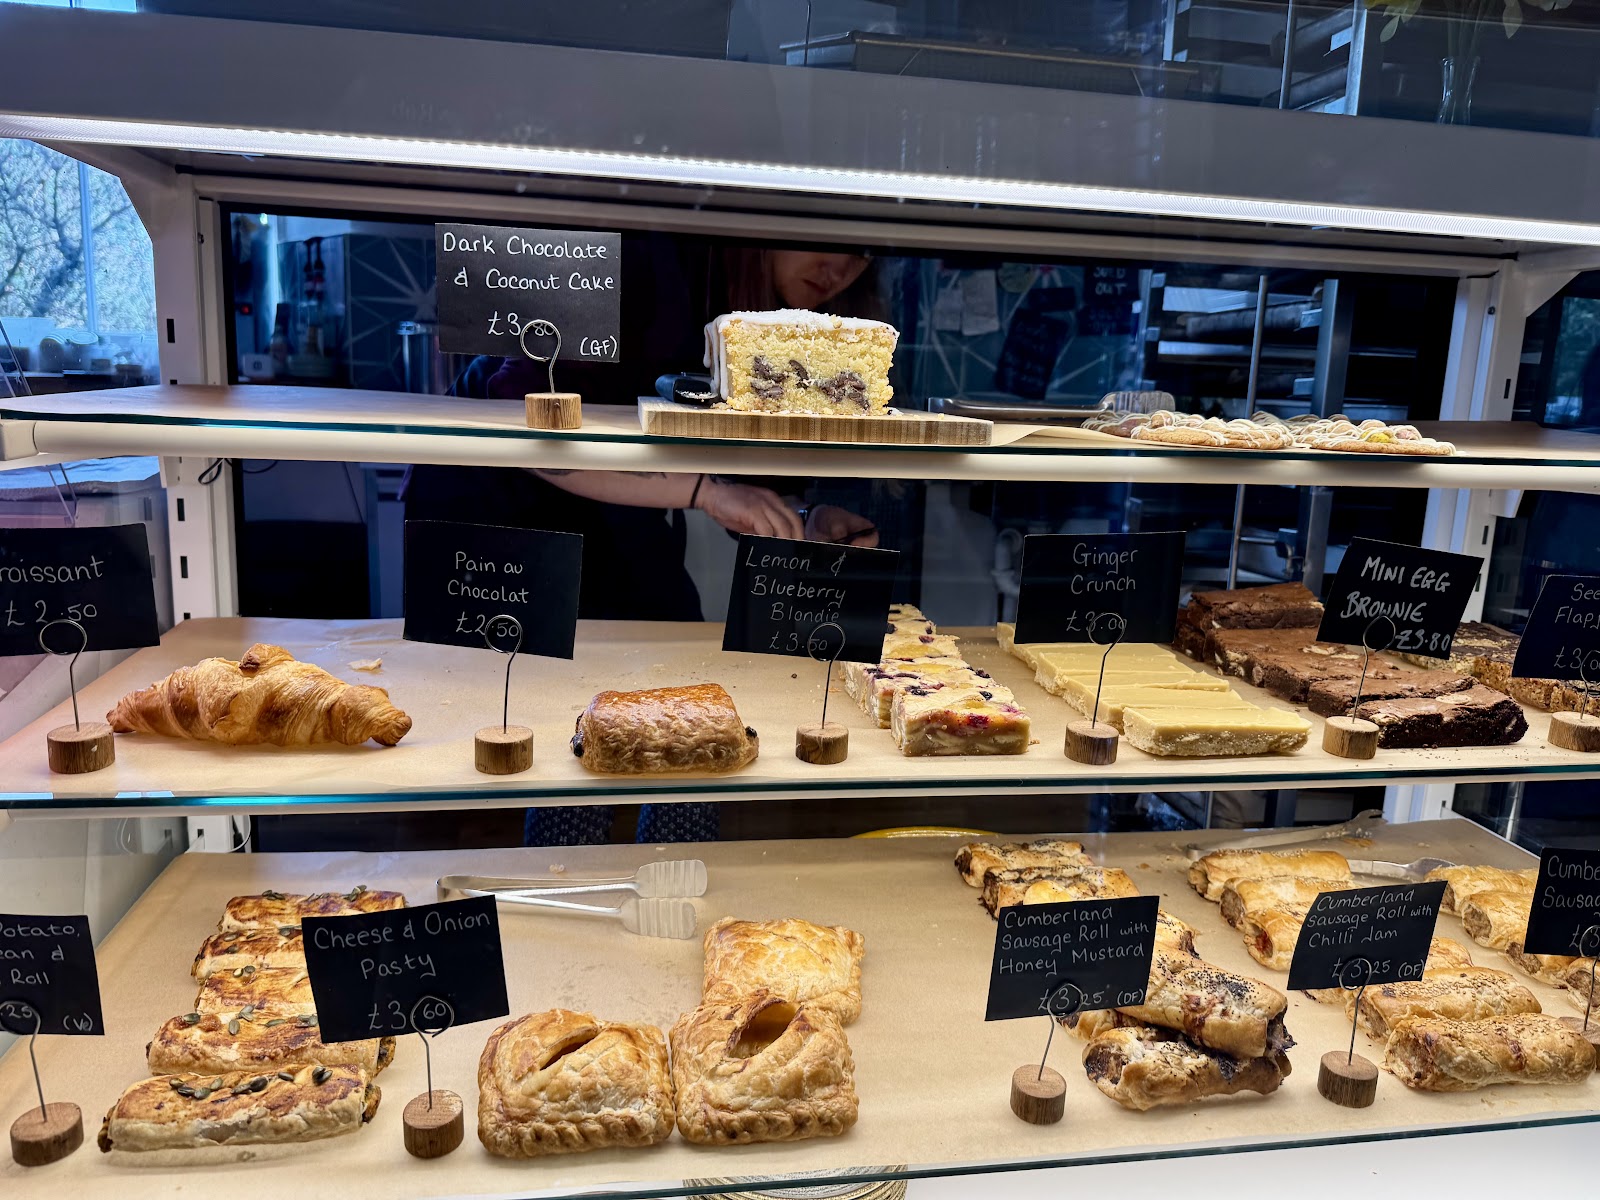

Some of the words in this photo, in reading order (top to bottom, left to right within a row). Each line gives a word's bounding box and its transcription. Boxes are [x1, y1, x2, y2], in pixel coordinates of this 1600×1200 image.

[443, 232, 496, 254] Dark
[506, 235, 607, 259] Chocolate
[454, 267, 468, 287] &
[485, 268, 560, 290] Coconut
[568, 272, 614, 291] Cake
[487, 311, 556, 336] £3.80
[579, 335, 618, 358] (GF)
[455, 551, 496, 573] Pain
[503, 562, 523, 575] au
[745, 546, 810, 571] Lemon
[1072, 542, 1139, 576] Ginger
[1070, 574, 1136, 595] Crunch
[1360, 556, 1406, 585] MINI
[1409, 566, 1451, 593] EGG
[447, 579, 530, 604] Chocolat
[750, 574, 846, 609] Blueberry
[770, 602, 840, 623] Blondie
[1340, 591, 1428, 623] BROWNIE
[455, 611, 520, 637] £2.50
[1316, 889, 1415, 912] Cumberland
[1376, 905, 1406, 921] Roll
[1410, 904, 1433, 917] with
[0, 921, 80, 938] otato,
[1004, 906, 1113, 929] Cumberland
[314, 927, 395, 950] Cheese
[402, 919, 416, 940] &
[424, 911, 491, 935] Onion
[1002, 933, 1072, 955] Sausage
[1078, 923, 1109, 942] Roll
[1119, 921, 1150, 937] with
[1308, 929, 1353, 949] Chilli
[1360, 925, 1398, 944] Jam
[360, 953, 436, 980] Pasty
[999, 958, 1057, 978] Honey
[1071, 942, 1145, 964] Mustard
[1397, 958, 1425, 979] (DF)
[10, 968, 50, 985] Roll
[1116, 988, 1145, 1006] (DF)
